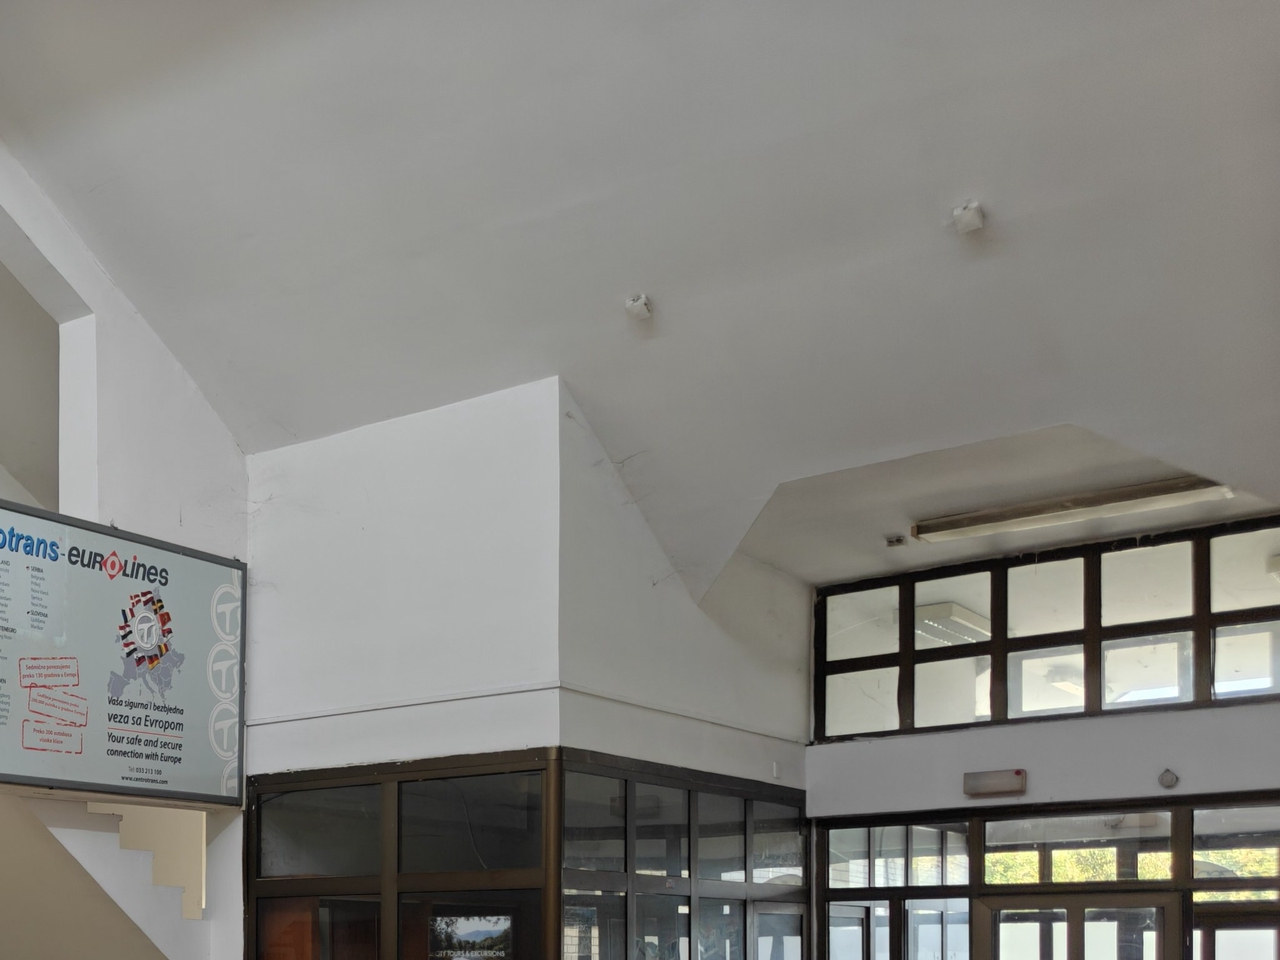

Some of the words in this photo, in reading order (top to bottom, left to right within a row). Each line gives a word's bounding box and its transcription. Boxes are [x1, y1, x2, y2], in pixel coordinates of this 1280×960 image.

[30, 566, 44, 574] SERBIA
[30, 609, 49, 618] SLOVENIA
[107, 695, 124, 706] Vaša
[124, 698, 149, 711] sigurna
[153, 702, 185, 715] bezbjedna
[107, 712, 130, 724] veza
[131, 715, 142, 726] sa
[144, 714, 184, 733] Evropom
[107, 731, 126, 744] Your
[126, 735, 142, 747] safe
[143, 737, 159, 749] and
[159, 740, 183, 751] secure
[106, 748, 144, 760] connection
[144, 751, 159, 761] with
[160, 752, 182, 765] Europe
[135, 767, 145, 775] 033
[121, 775, 169, 785] www.centrotrans.com
